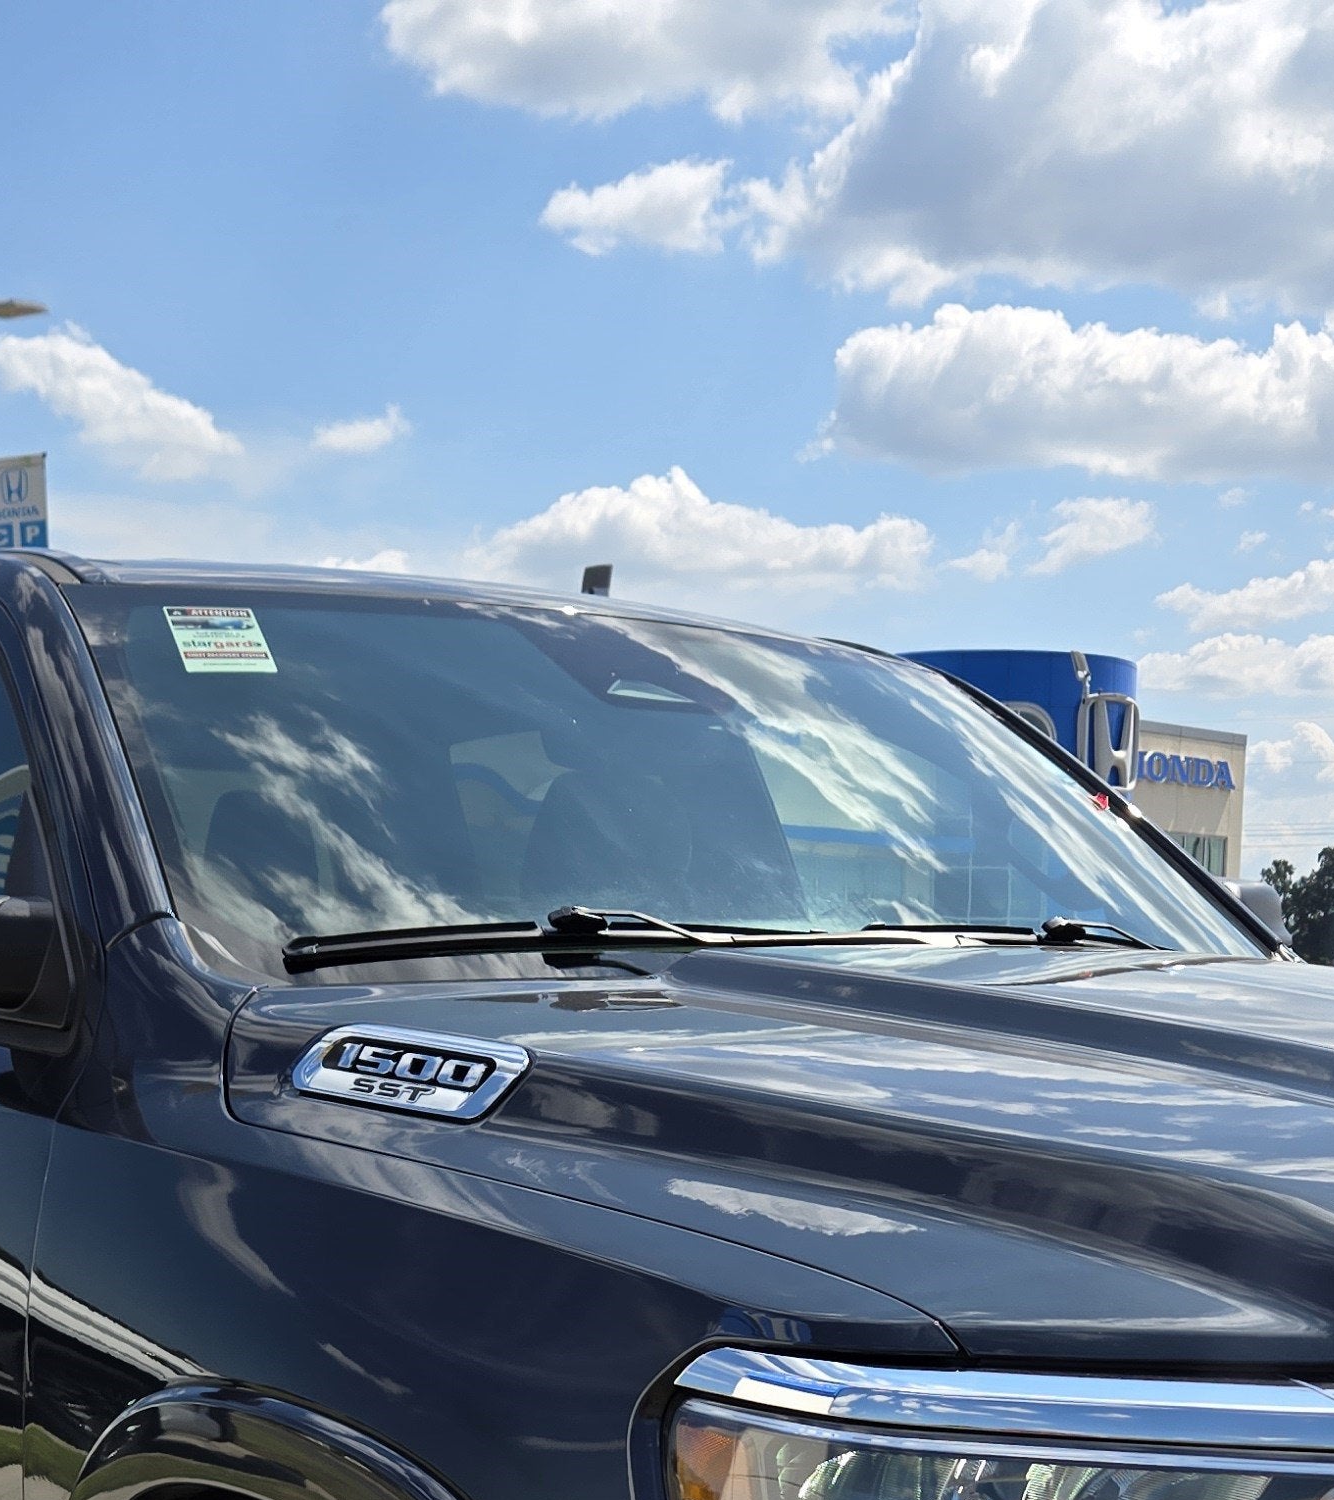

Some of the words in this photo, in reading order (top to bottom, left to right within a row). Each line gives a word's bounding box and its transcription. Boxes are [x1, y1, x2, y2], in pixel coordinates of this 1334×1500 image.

[190, 608, 248, 618] ATTENTION
[337, 1042, 488, 1088] 1500
[349, 1076, 436, 1103] SST
